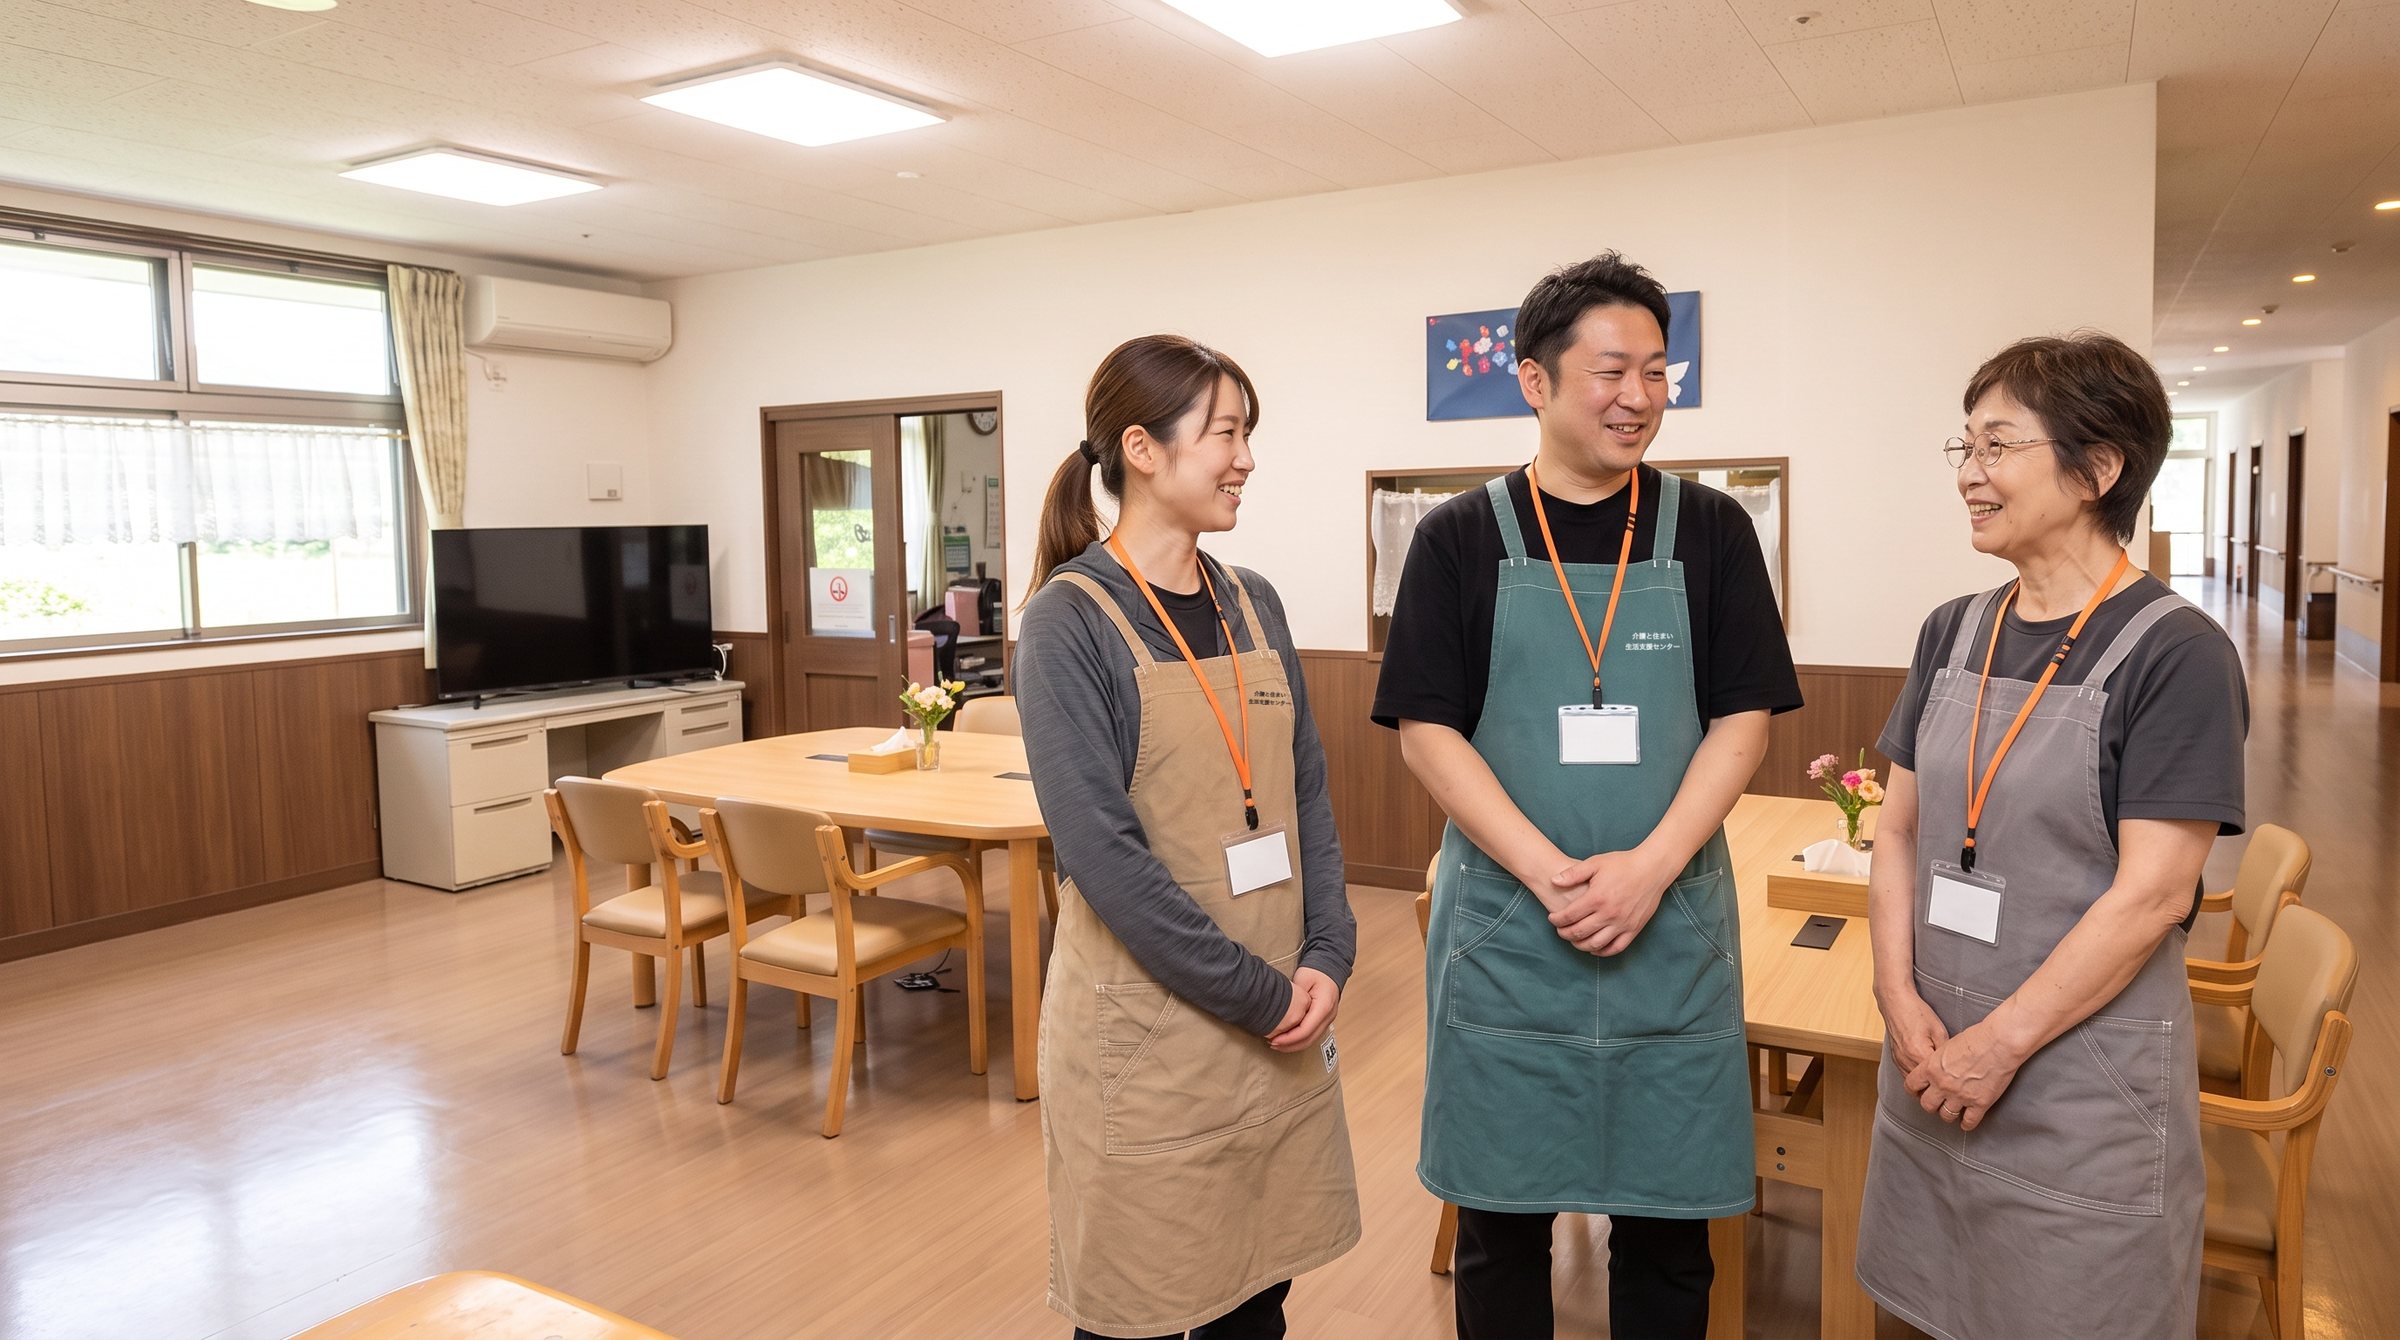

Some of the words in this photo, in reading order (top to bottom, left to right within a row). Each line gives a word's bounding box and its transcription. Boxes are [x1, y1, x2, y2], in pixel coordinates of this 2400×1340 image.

[1632, 632, 1674, 640] 介護と住まい
[1625, 643, 1680, 651] 生活支援センター
